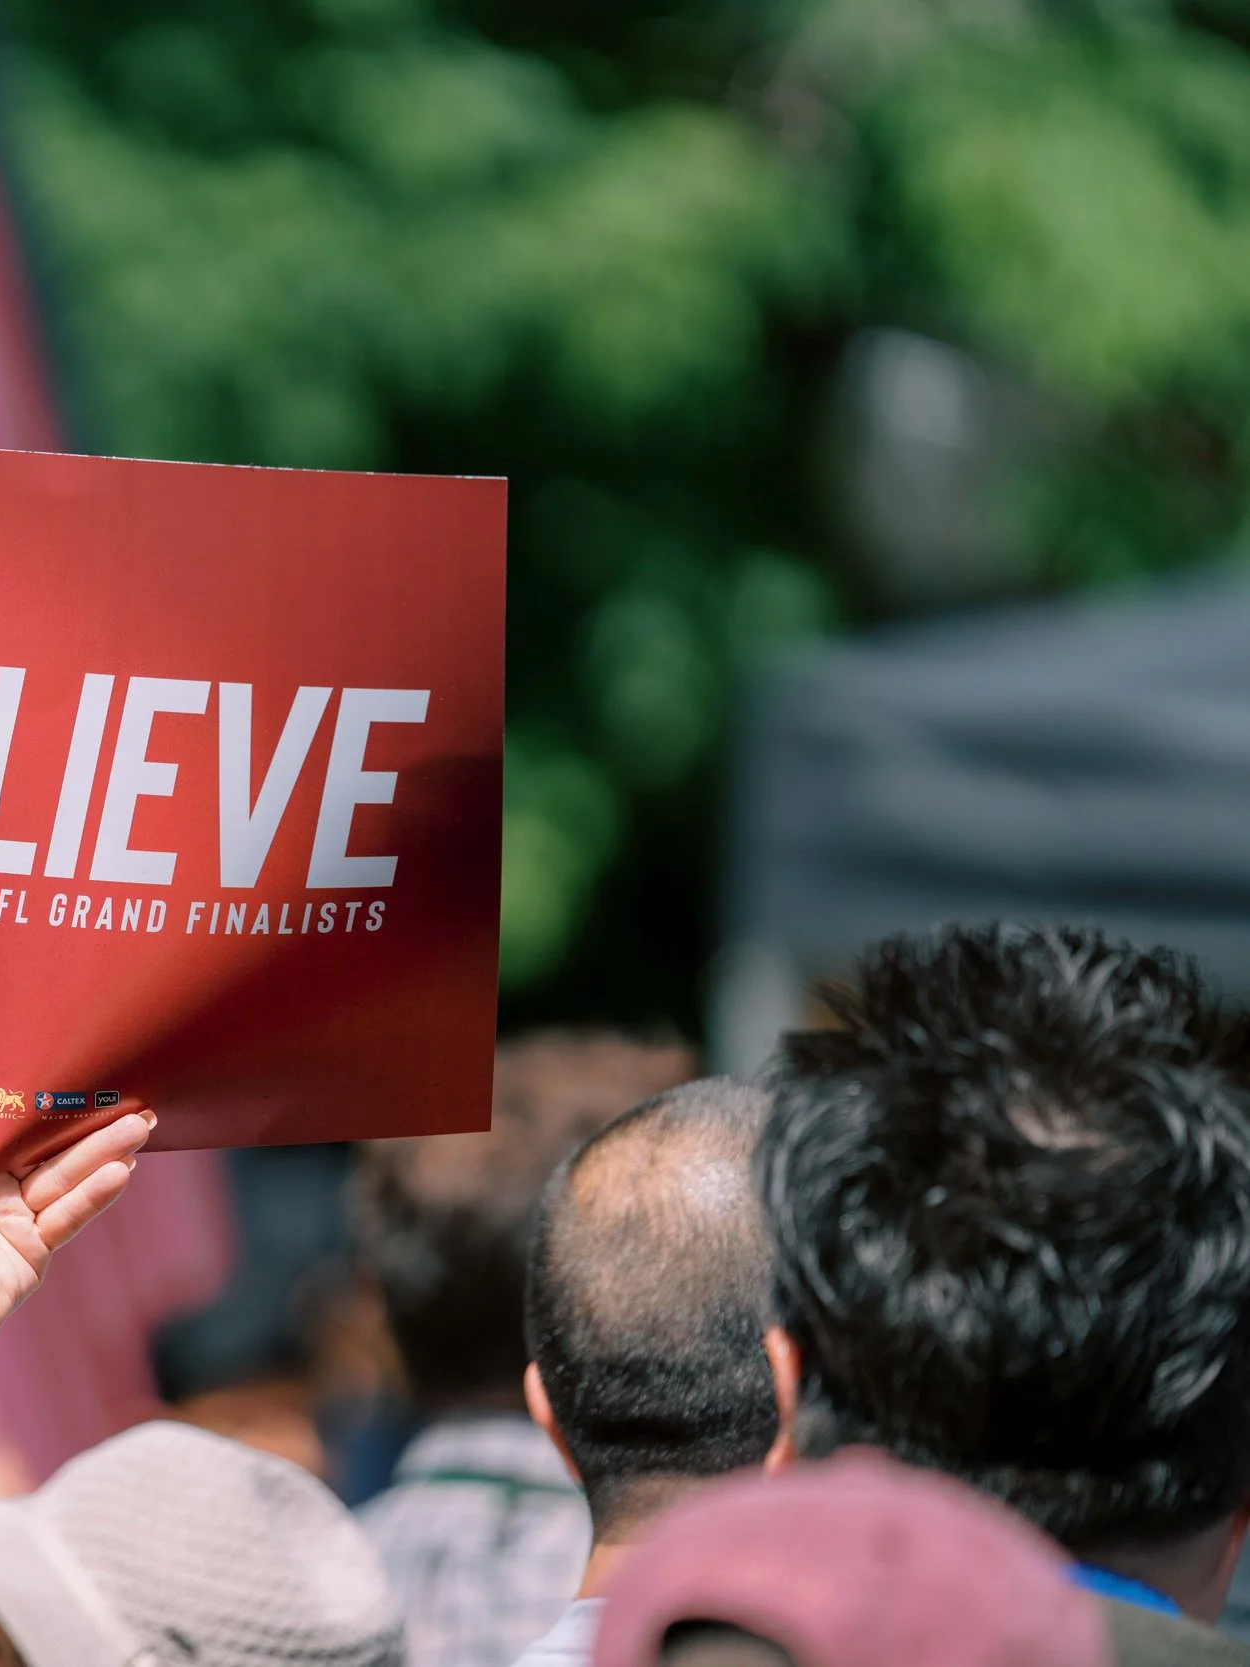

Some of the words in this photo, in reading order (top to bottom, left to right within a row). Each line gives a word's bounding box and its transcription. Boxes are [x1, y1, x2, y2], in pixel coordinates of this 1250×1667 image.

[48, 894, 167, 933] GRAND
[187, 901, 388, 936] FINALISTS
[57, 1097, 86, 1105] CALTEX
